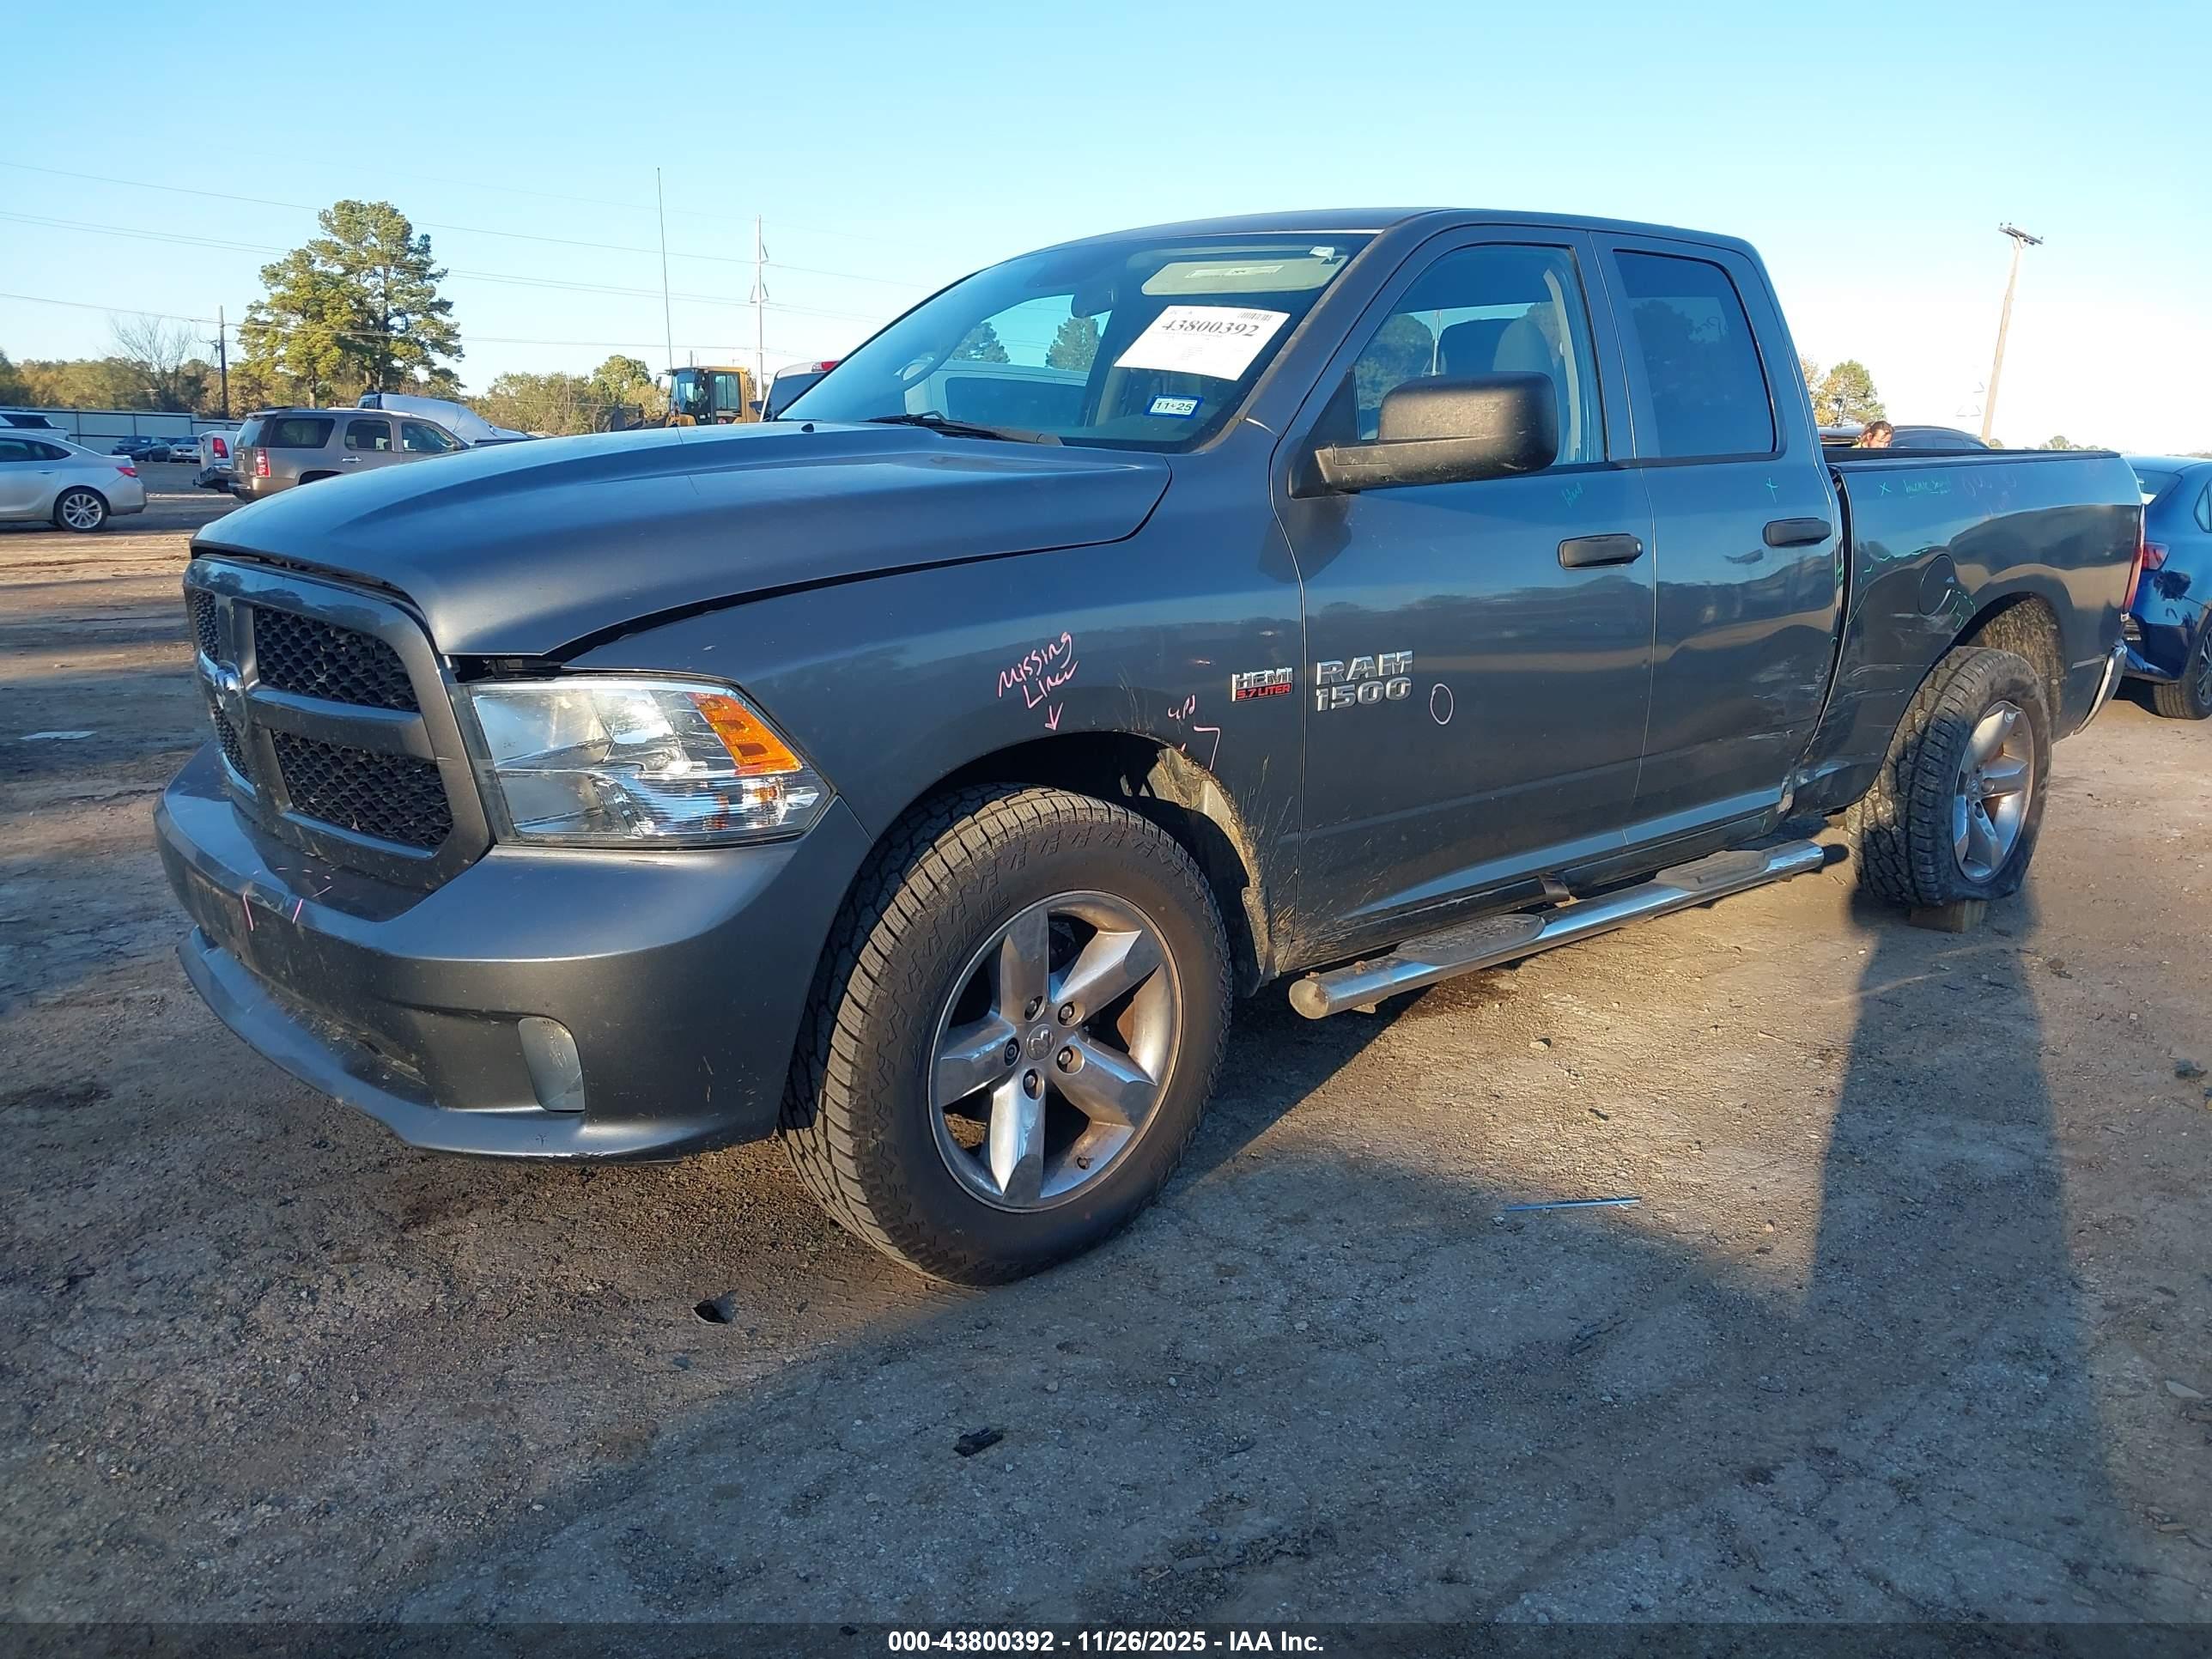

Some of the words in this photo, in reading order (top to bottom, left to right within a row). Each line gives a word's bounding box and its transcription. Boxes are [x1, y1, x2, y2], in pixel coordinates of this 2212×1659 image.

[1162, 319, 1260, 337] 43800392
[1231, 667, 1293, 688] HEMI
[1316, 650, 1413, 685] RAM
[1237, 687, 1257, 700] 5.7
[1258, 684, 1291, 697] LITER
[1316, 677, 1413, 712] 1500
